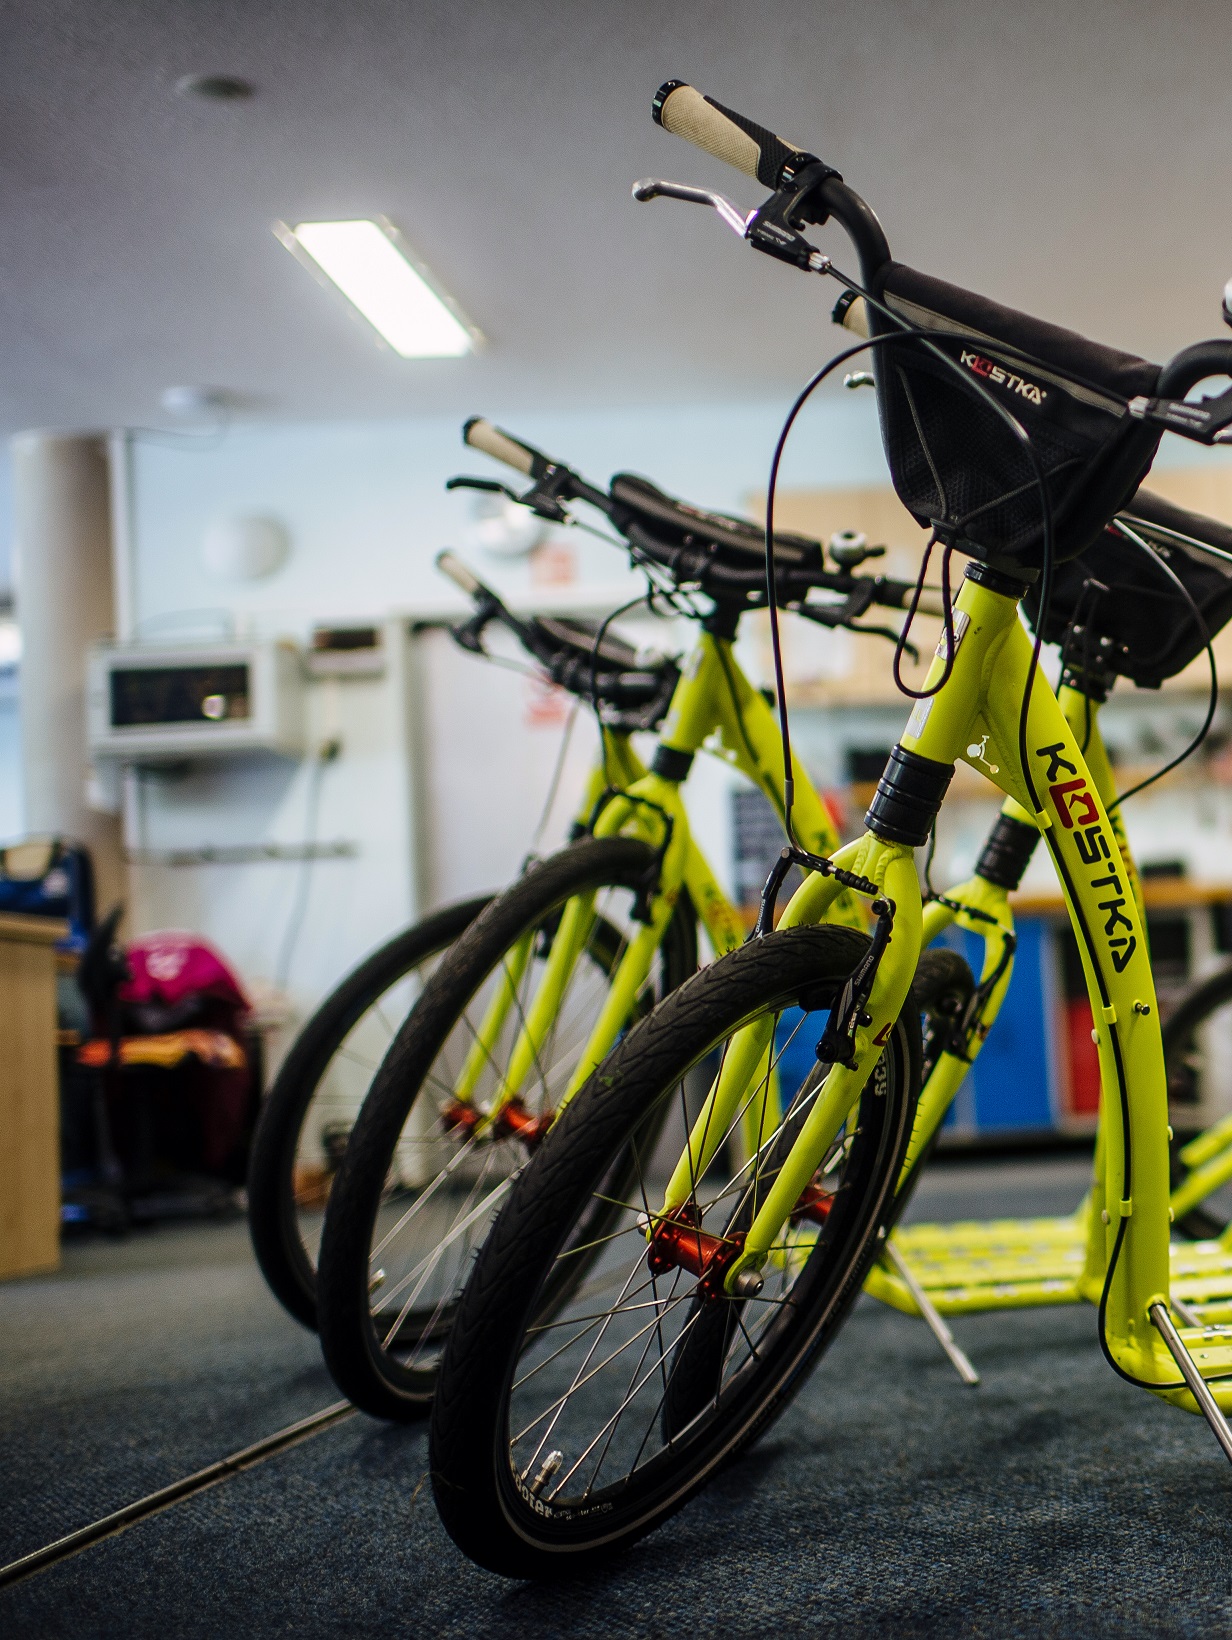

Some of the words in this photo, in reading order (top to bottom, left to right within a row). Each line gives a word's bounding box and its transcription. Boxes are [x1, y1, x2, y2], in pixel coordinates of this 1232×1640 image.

[959, 350, 1043, 405] KOSTKA
[1036, 742, 1137, 973] KOSTKA
[854, 955, 875, 986] SHIMANO
